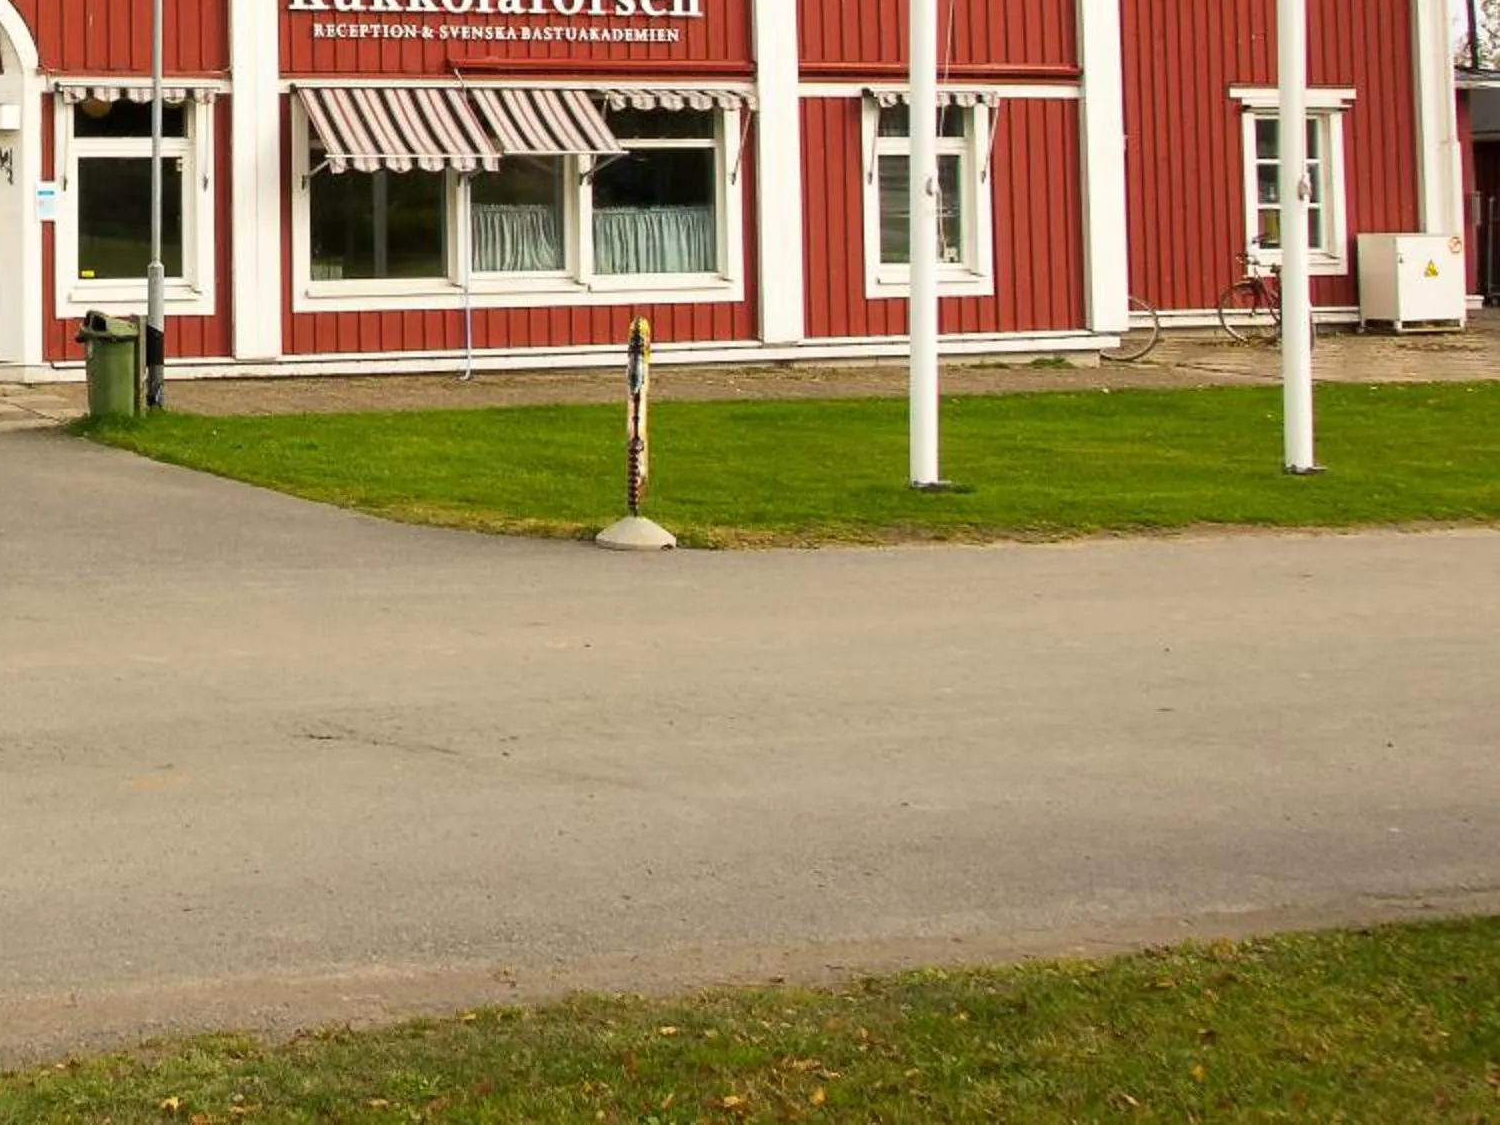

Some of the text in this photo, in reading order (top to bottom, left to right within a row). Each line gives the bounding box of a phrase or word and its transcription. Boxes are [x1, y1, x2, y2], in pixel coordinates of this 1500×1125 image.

[314, 23, 679, 42] RECEPTION & SVENSKA BASTUAKADEMIEN
